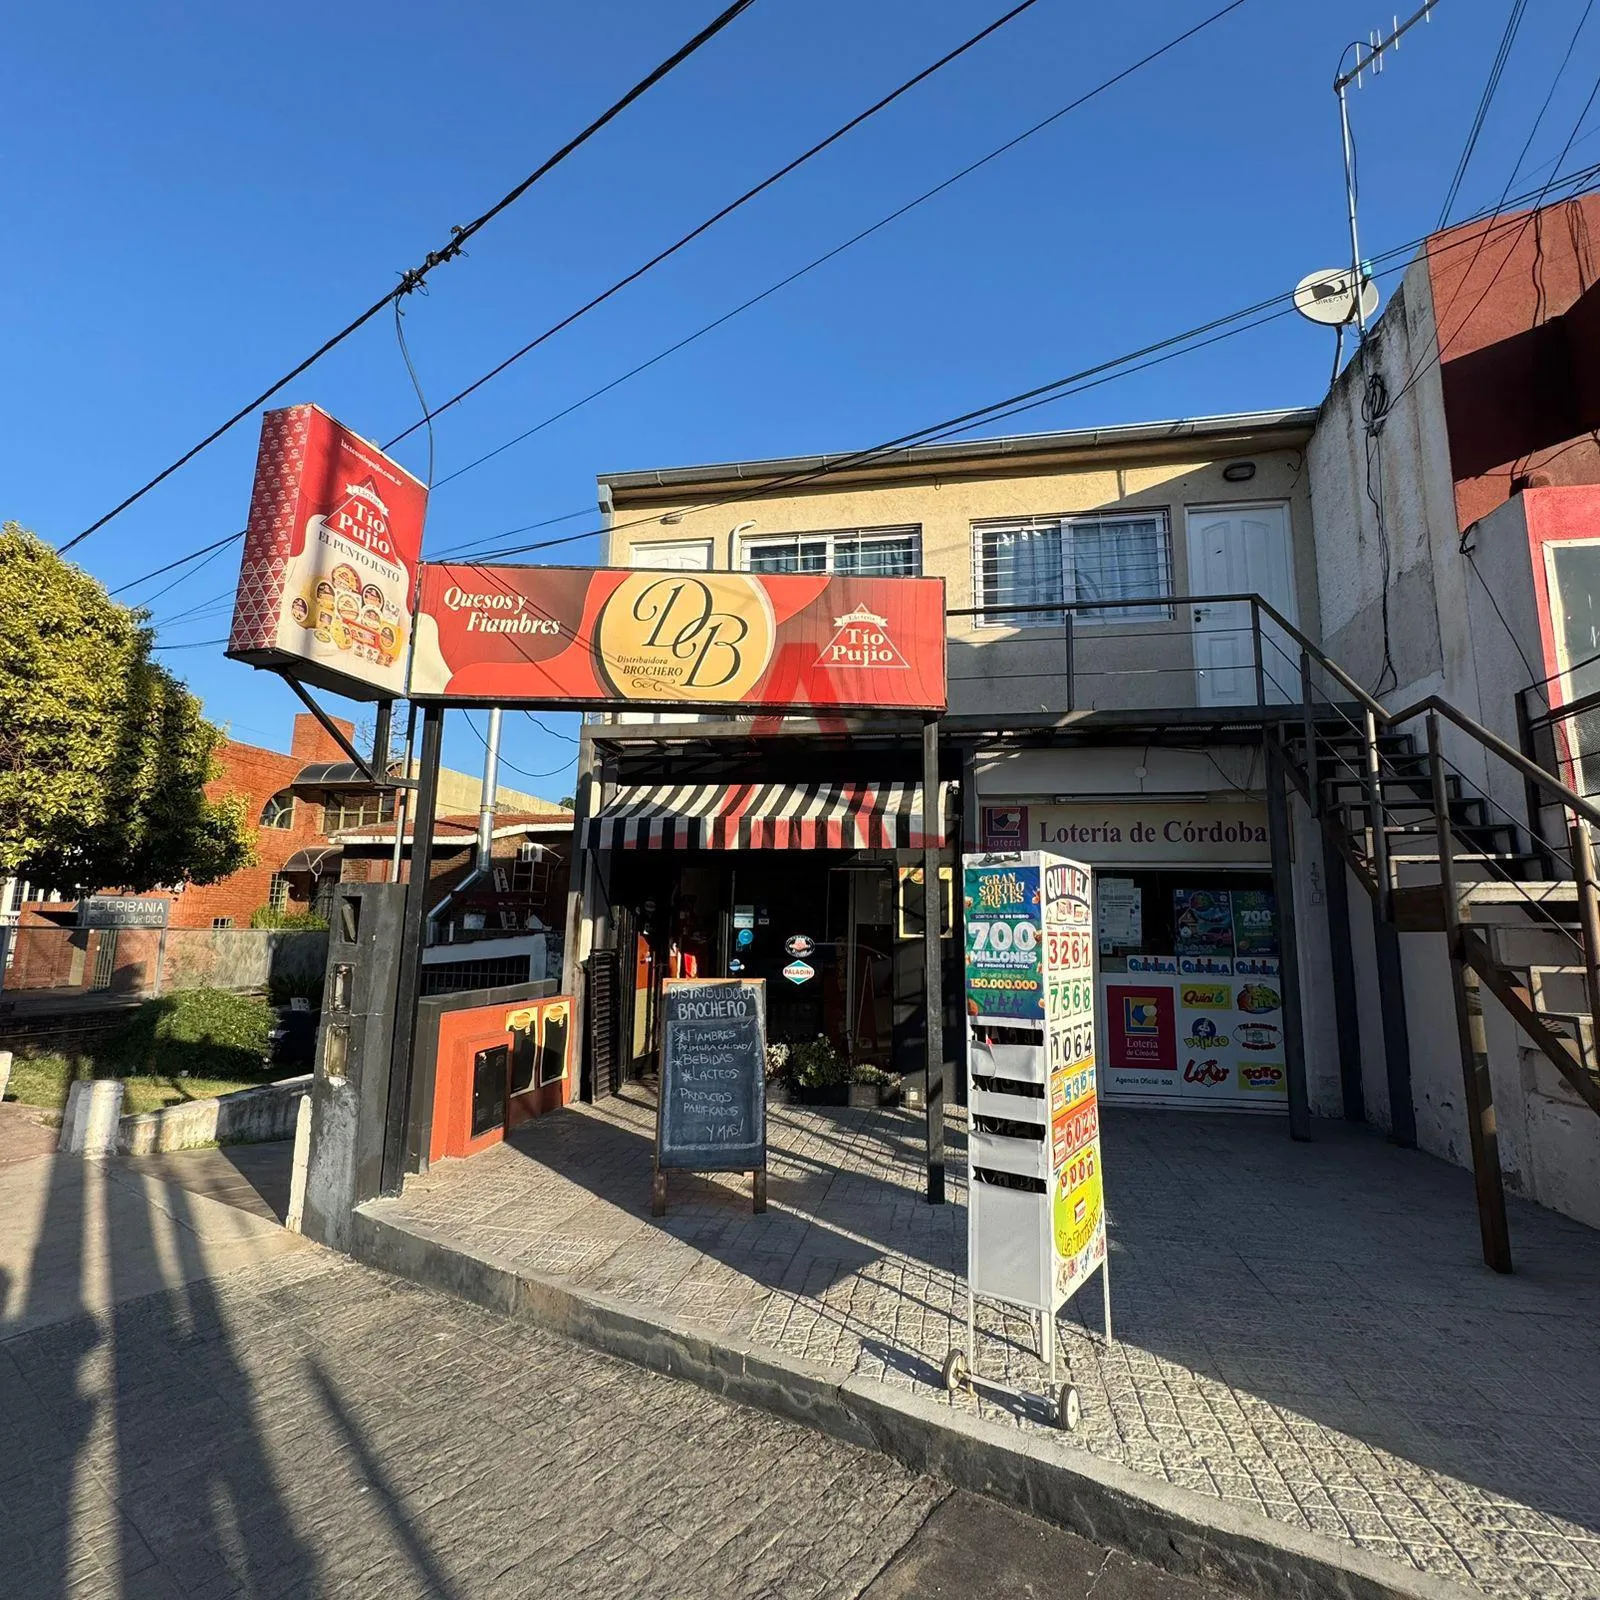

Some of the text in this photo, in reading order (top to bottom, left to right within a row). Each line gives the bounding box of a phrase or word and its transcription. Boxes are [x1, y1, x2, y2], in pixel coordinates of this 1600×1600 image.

[1315, 294, 1349, 305] DIRECTV
[353, 501, 385, 533] Tío
[338, 511, 390, 555] Pujio
[318, 531, 331, 546] EL
[333, 539, 369, 566] PUNTO
[370, 560, 400, 583] JUSTO
[443, 586, 528, 615] Quesos y
[466, 611, 561, 635] Fiambres
[845, 628, 884, 646] Tío
[617, 654, 668, 665] Distribuidora
[831, 645, 893, 667] Pujio
[623, 664, 684, 677] BROCHERO
[1039, 820, 1268, 844] Lotería de Córdoba
[984, 873, 1016, 886] GRAN
[968, 921, 1037, 951] 700
[971, 950, 1037, 963] MILLONES
[1050, 940, 1089, 966] 3261
[670, 986, 756, 1000] DISTRIBUIDORA
[1051, 987, 1090, 1014] 7568
[678, 1000, 746, 1020] BROCHERO
[687, 1029, 736, 1042] FIAMBRES
[1053, 1032, 1092, 1062] 1064
[682, 1053, 735, 1066] BEBIDAS
[692, 1065, 740, 1081] LACTEOS
[706, 1124, 715, 1142] Y
